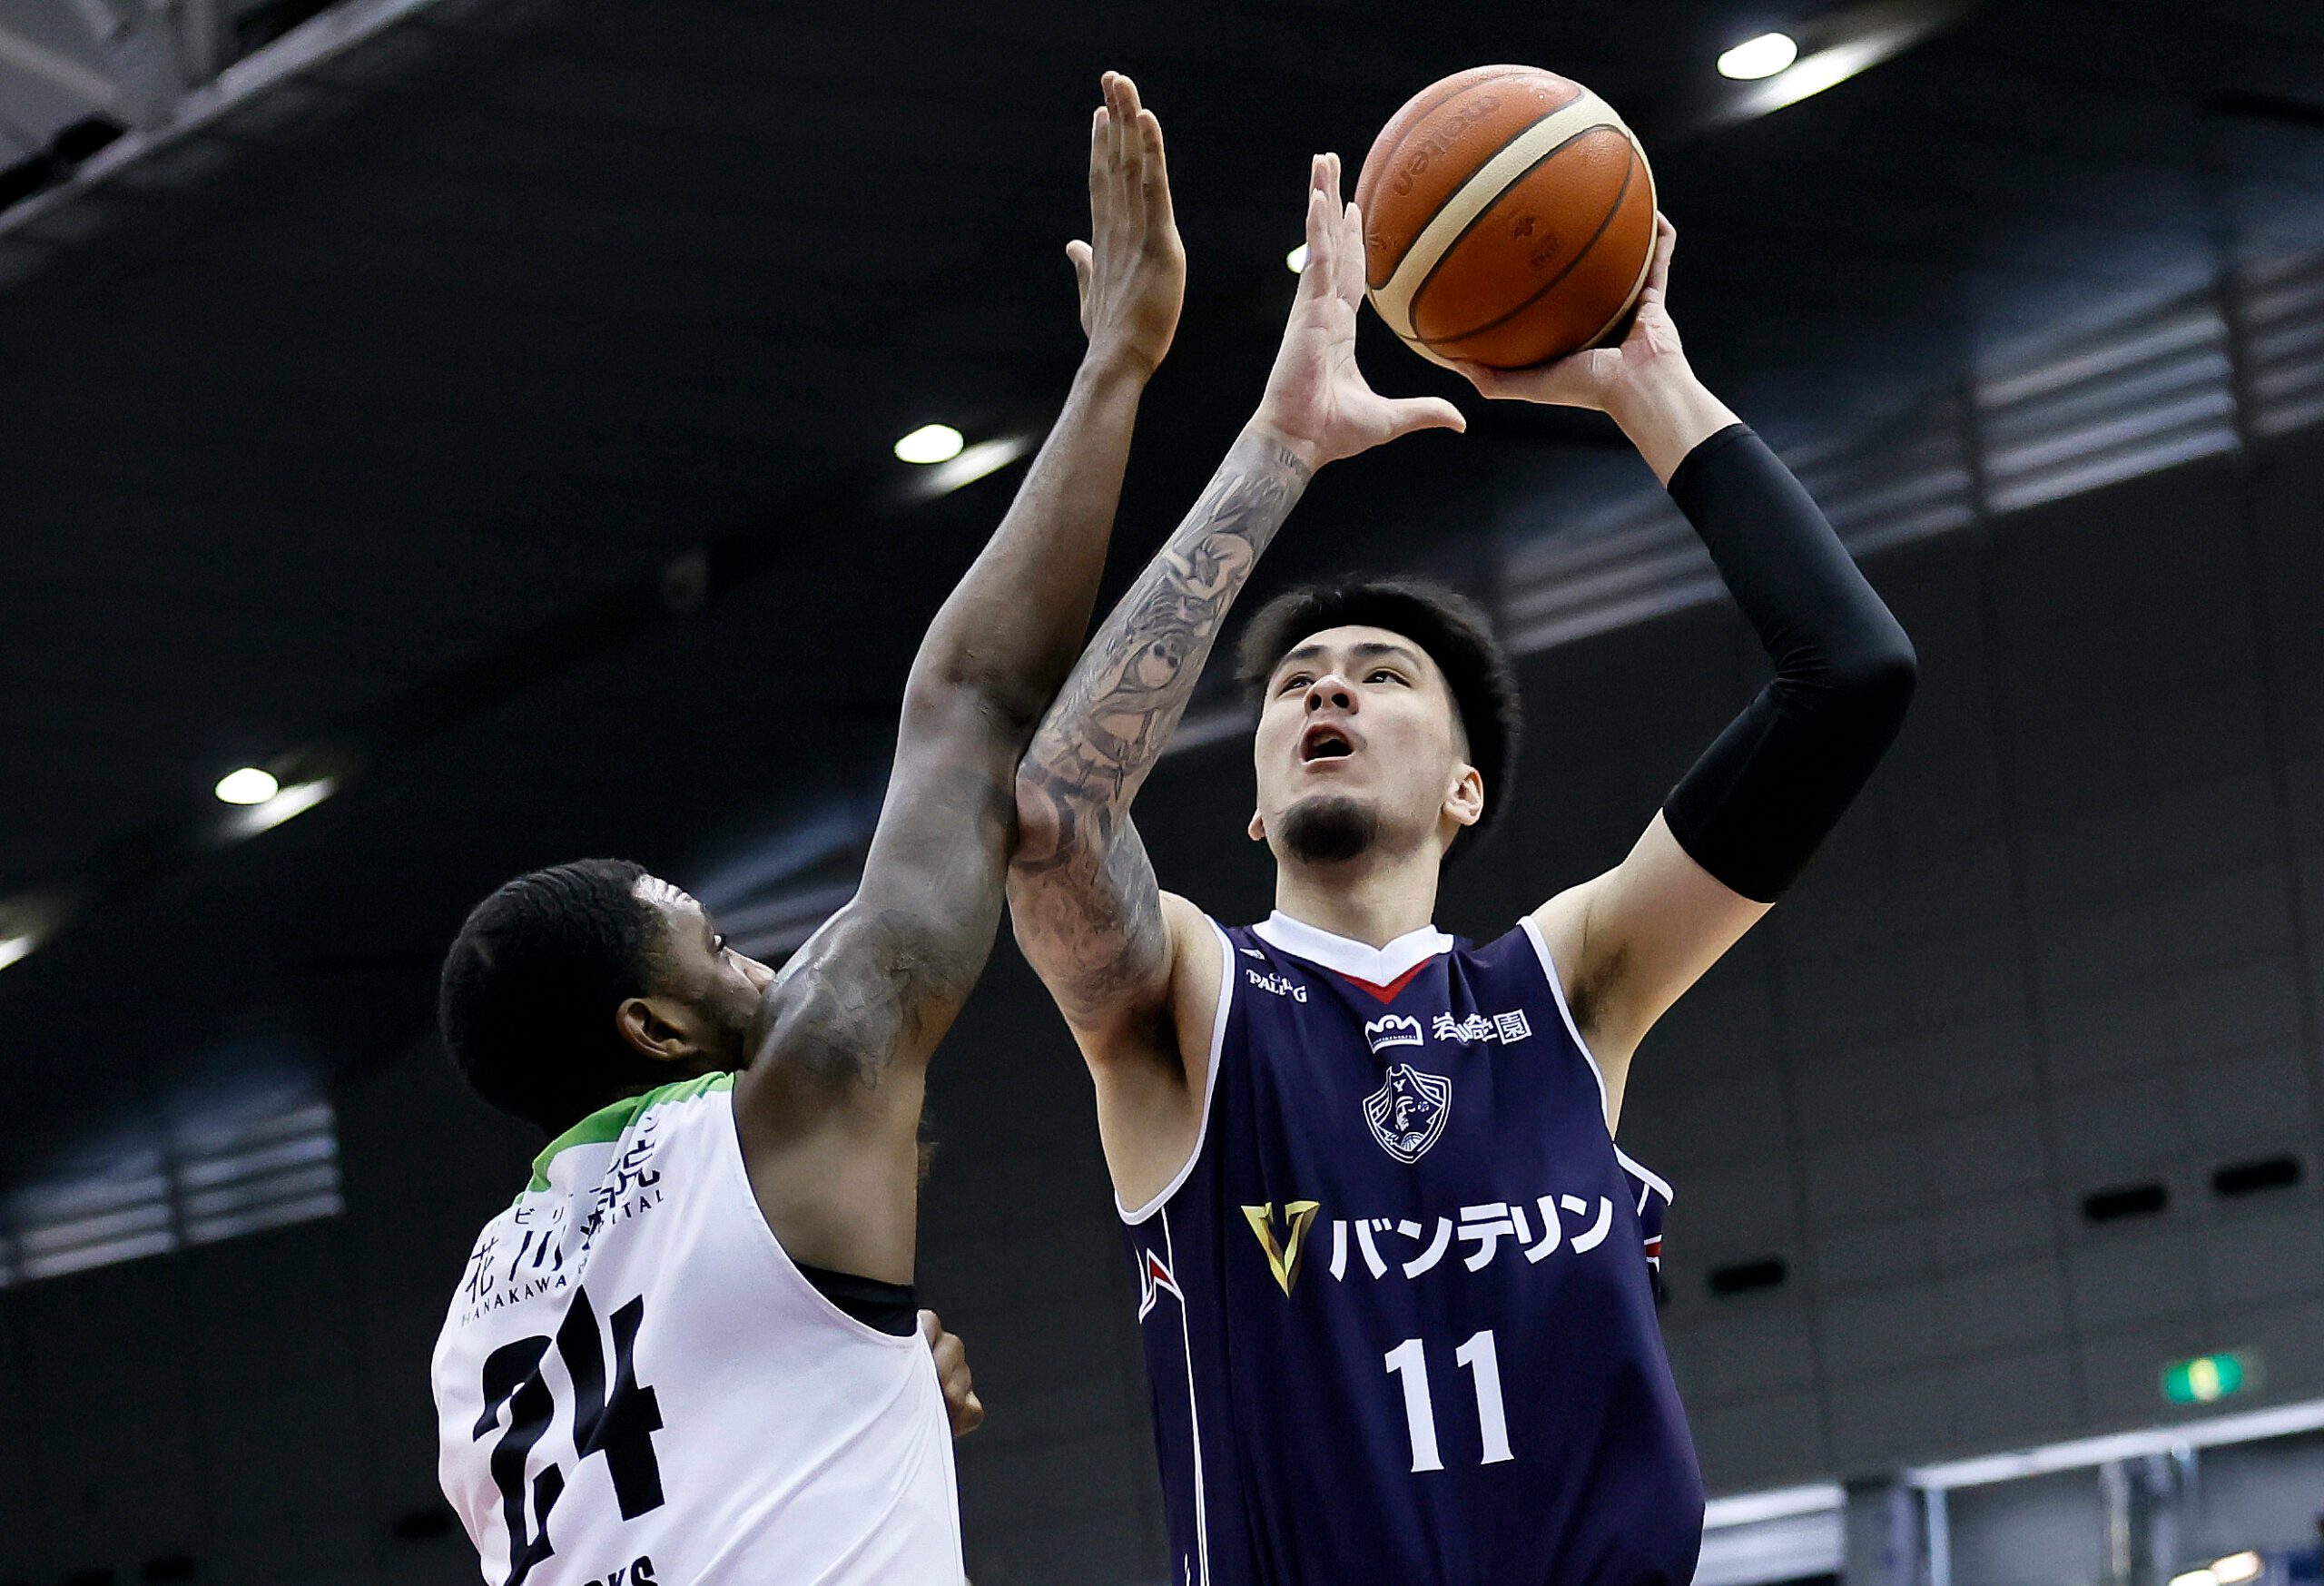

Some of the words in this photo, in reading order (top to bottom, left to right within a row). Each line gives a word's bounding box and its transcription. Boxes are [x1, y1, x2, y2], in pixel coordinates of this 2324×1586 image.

[1329, 1194, 1613, 1282] バンテリン
[461, 1275, 567, 1327] HANAKAWA
[472, 1285, 665, 1586] 24
[1384, 1329, 1515, 1473] 11
